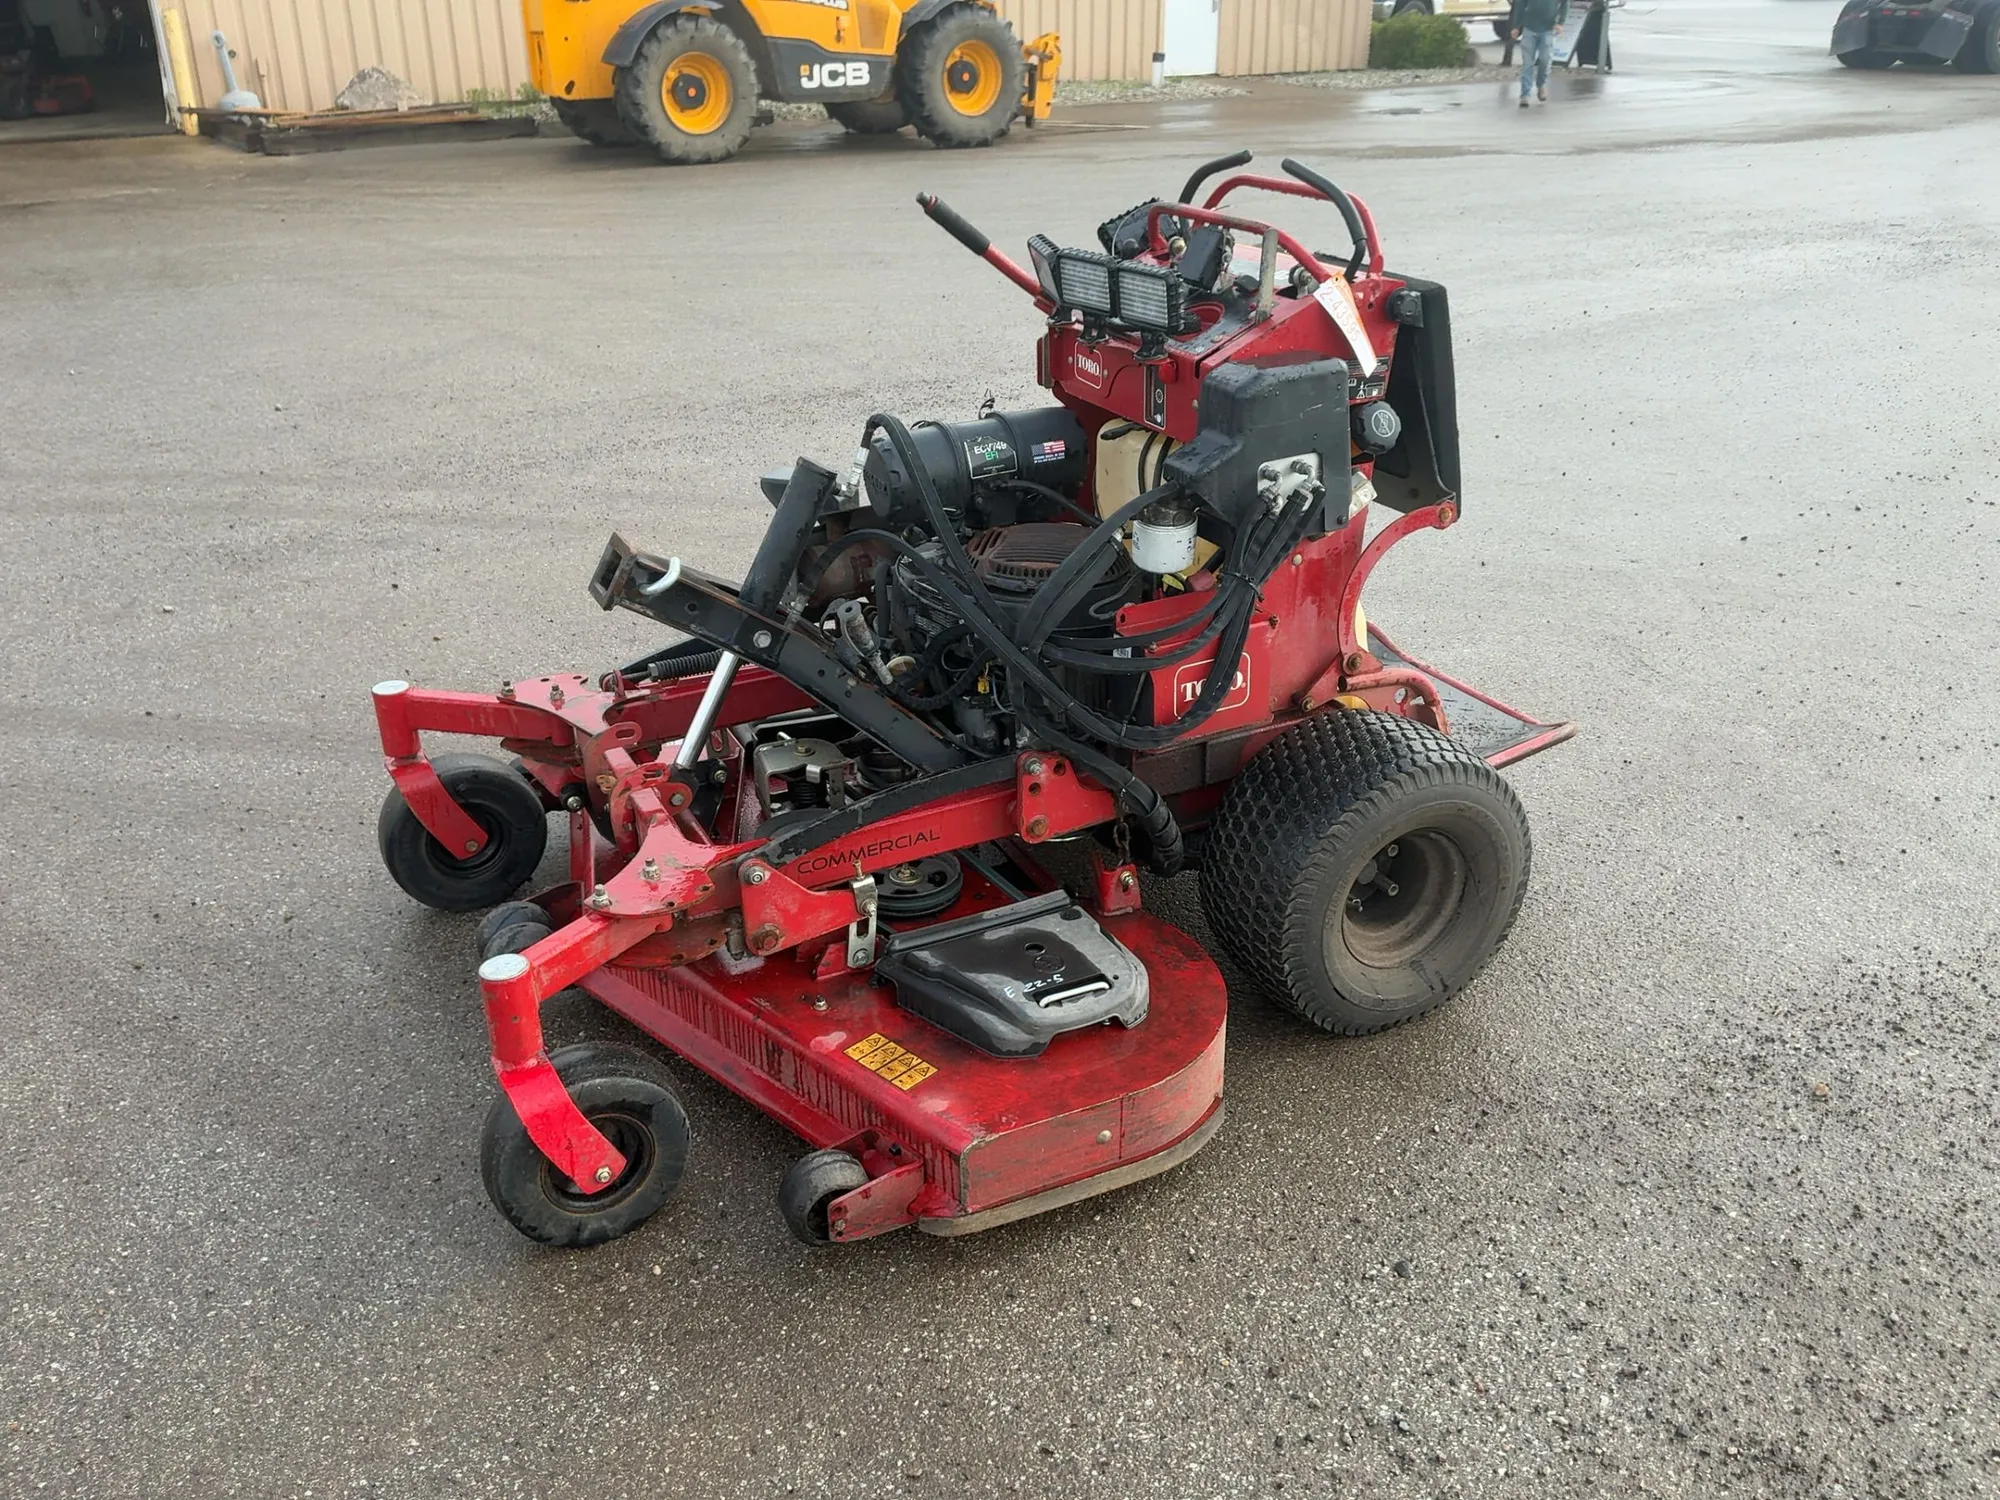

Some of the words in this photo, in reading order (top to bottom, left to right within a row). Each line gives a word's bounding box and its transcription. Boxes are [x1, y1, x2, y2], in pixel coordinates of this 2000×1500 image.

[800, 61, 870, 89] JCB
[1077, 353, 1100, 376] TORO
[984, 451, 999, 461] EFI
[797, 829, 941, 874] COMMERCIAL
[1003, 985, 1016, 999] E
